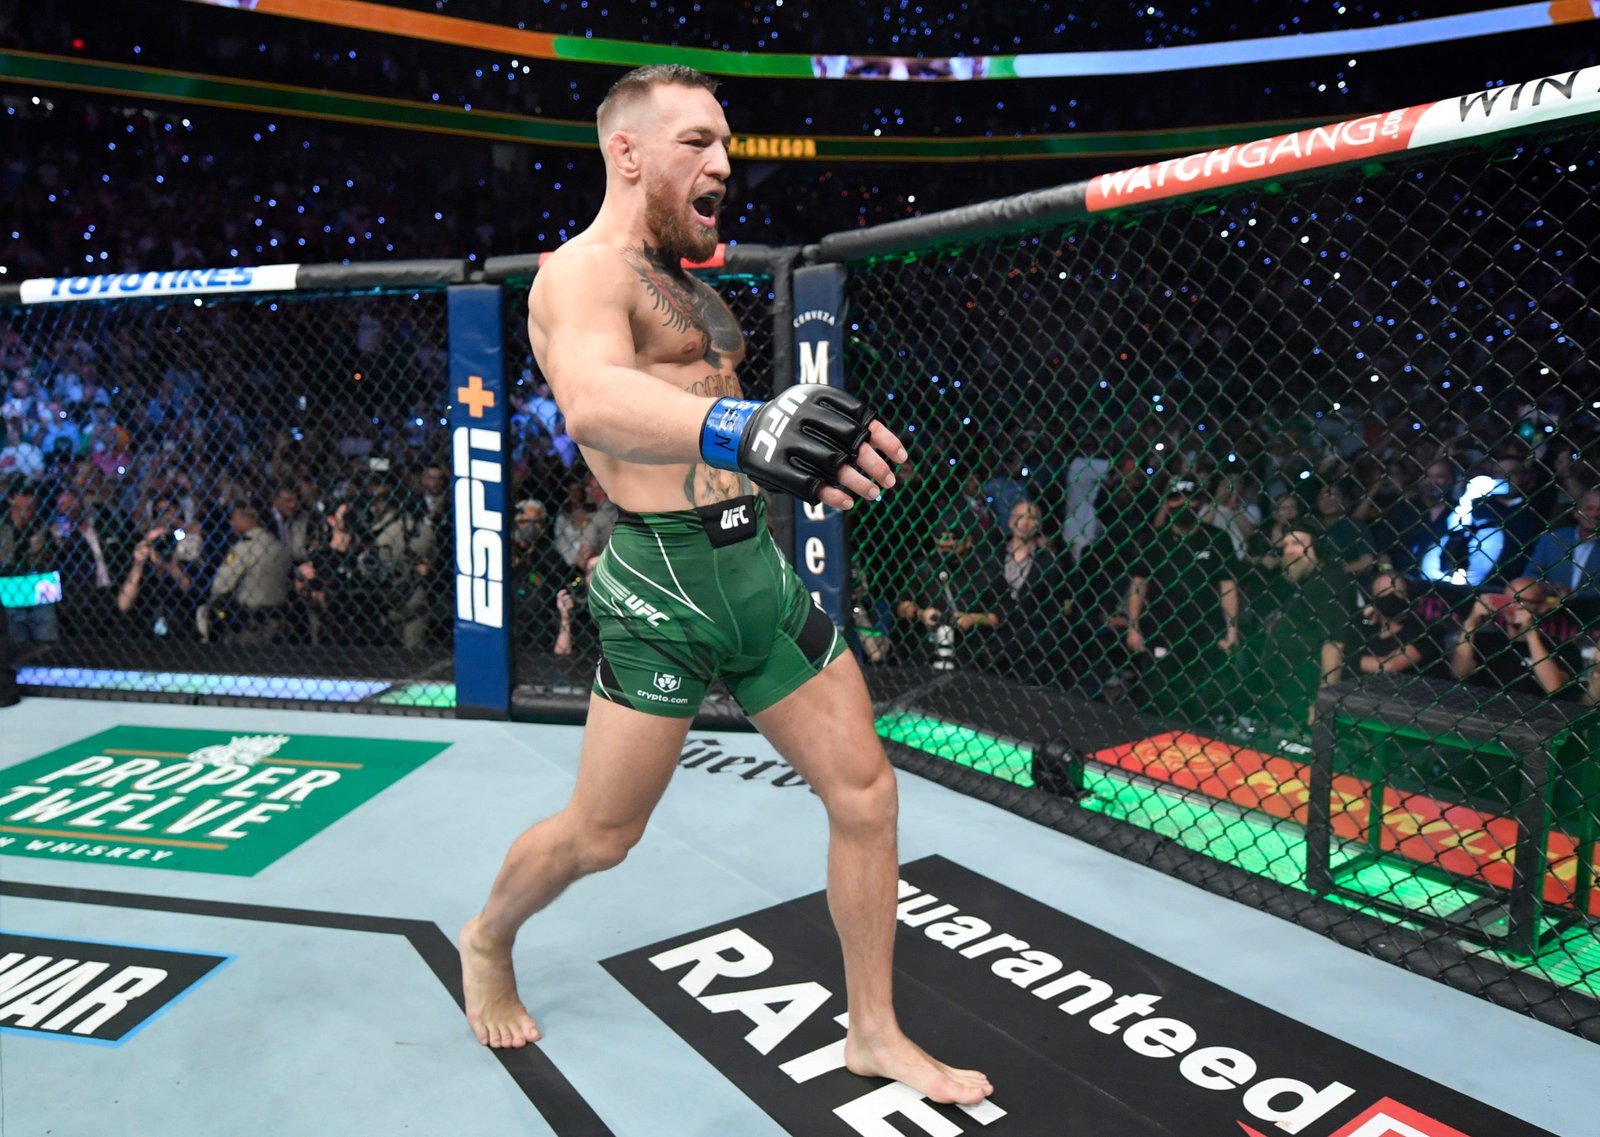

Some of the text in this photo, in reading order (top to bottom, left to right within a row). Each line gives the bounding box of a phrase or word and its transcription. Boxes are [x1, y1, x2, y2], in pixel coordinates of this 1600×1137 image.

[1459, 69, 1580, 123] WIN
[1100, 114, 1386, 199] WATCHGANG
[793, 310, 835, 328] CERVEZA
[752, 393, 808, 463] UFC
[720, 505, 749, 530] UFC
[624, 594, 670, 627] UFC
[637, 689, 688, 704] crypto.com
[33, 756, 341, 801] PROPER
[677, 738, 816, 794] uerv
[0, 785, 290, 838] TWELVE
[25, 839, 173, 861] WHISKEY
[897, 879, 1356, 1135] uaranteed
